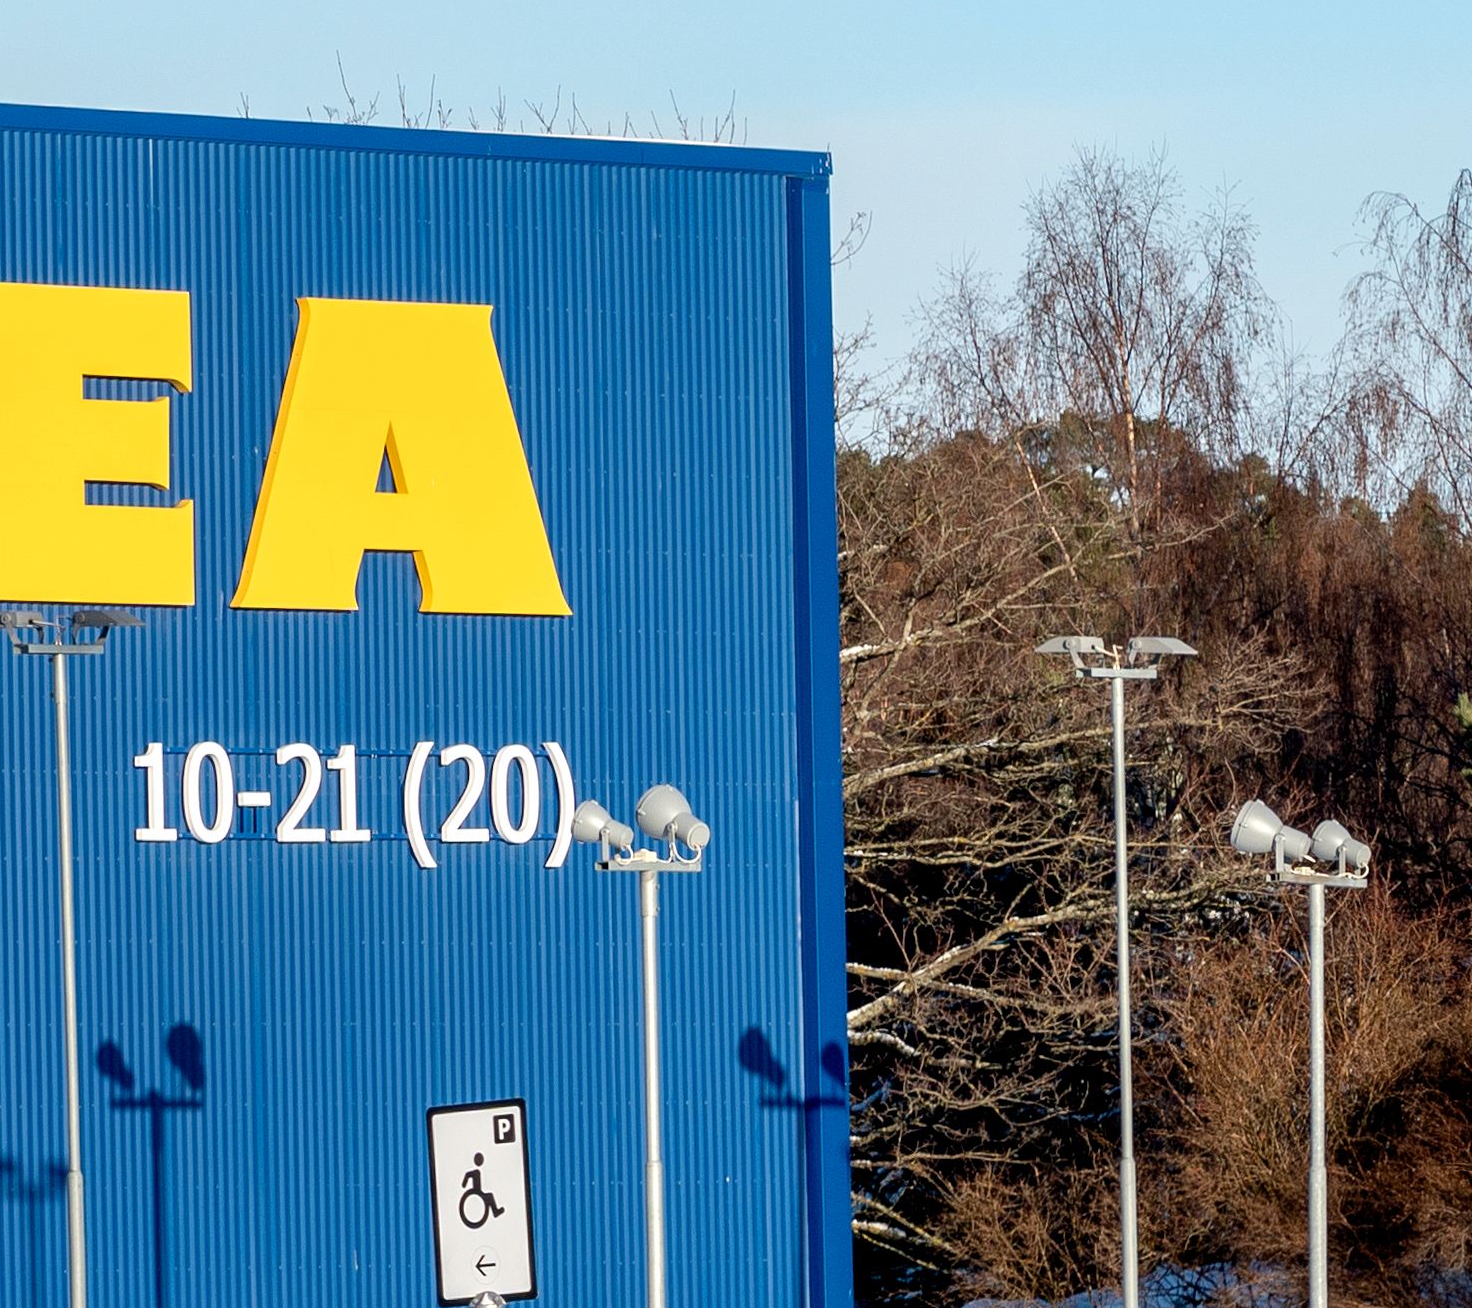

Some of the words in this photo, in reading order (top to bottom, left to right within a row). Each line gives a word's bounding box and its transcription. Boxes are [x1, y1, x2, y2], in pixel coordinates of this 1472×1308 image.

[134, 741, 371, 844] 10-21
[403, 741, 576, 869] (20)
[497, 1118, 512, 1141] P
